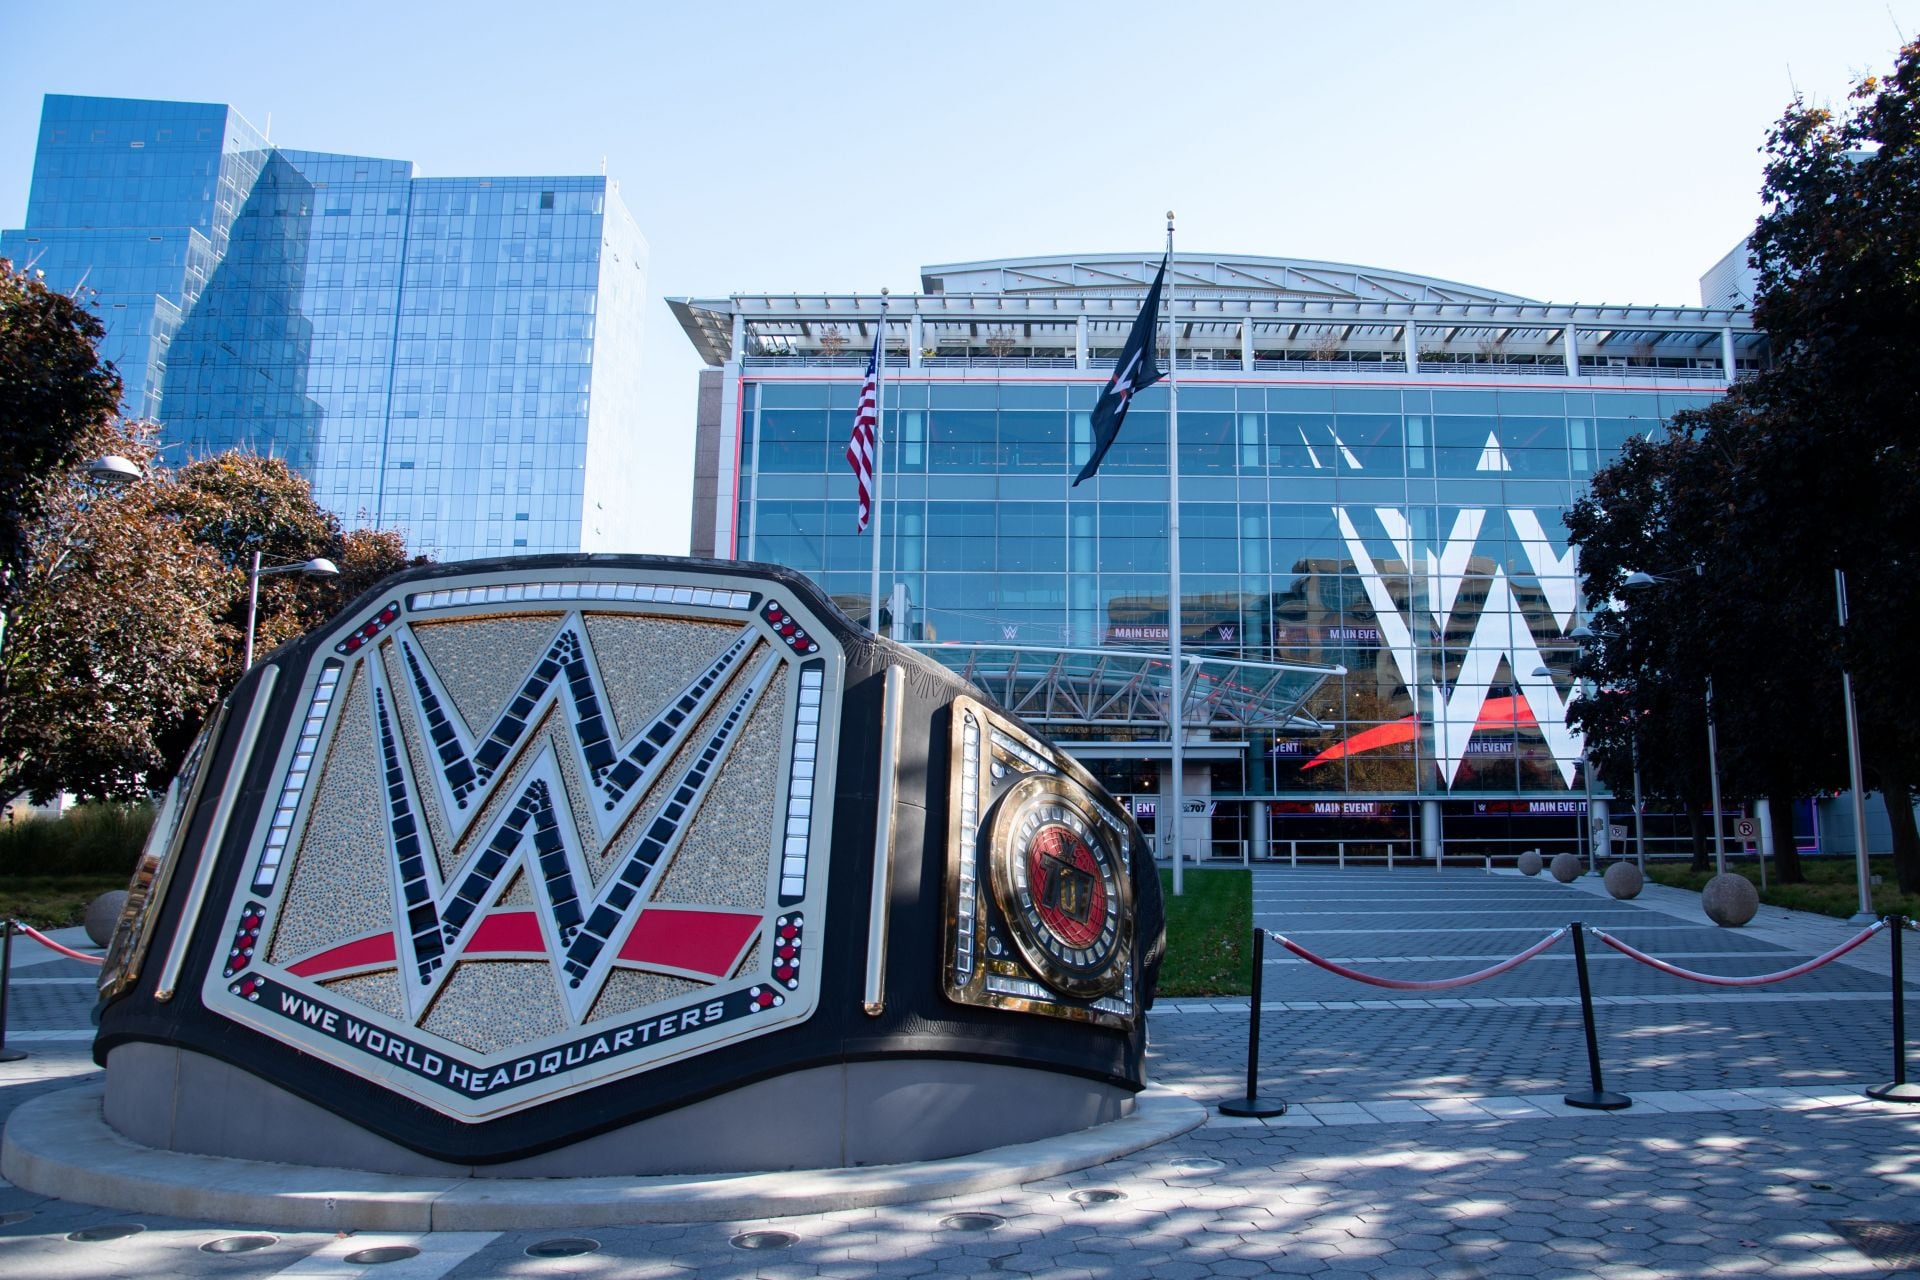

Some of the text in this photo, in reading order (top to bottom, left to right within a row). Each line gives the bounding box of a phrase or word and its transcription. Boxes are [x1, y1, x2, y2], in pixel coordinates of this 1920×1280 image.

[1115, 628, 1169, 638] MAIN EVEN
[1329, 629, 1382, 639] MAIN EVEN
[1274, 742, 1299, 753] VENT
[1465, 742, 1513, 753] AIN EVENT
[1190, 804, 1206, 813] 707
[1314, 802, 1341, 813] MAIN
[1343, 802, 1374, 813] EVENT
[1529, 802, 1556, 812] MAIN
[281, 991, 724, 1092] WWE WORLD HEADQUARTERS
